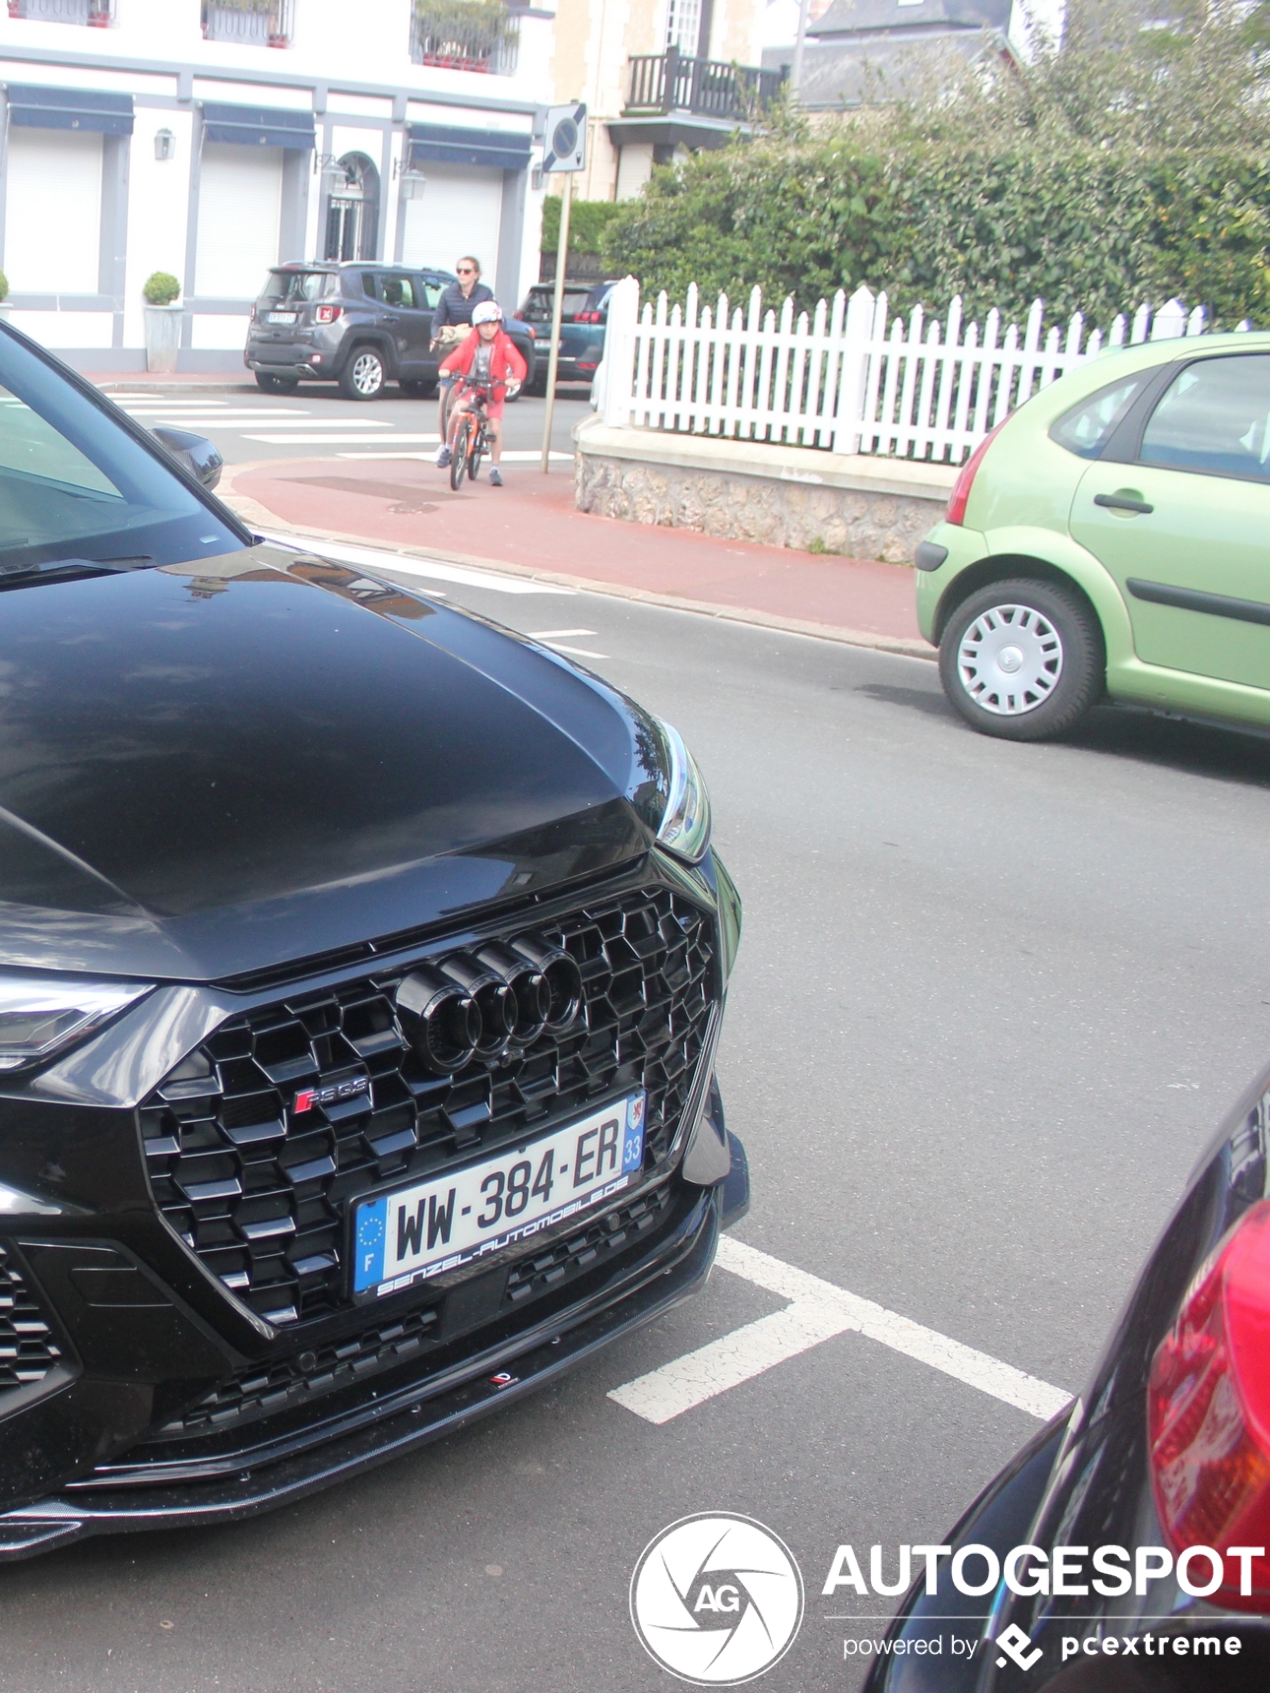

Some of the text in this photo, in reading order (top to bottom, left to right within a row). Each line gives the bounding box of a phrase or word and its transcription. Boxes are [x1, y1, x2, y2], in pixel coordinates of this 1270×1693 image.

[624, 1135, 641, 1165] 33
[396, 1118, 620, 1262] WW-384-ER
[364, 1253, 375, 1273] F
